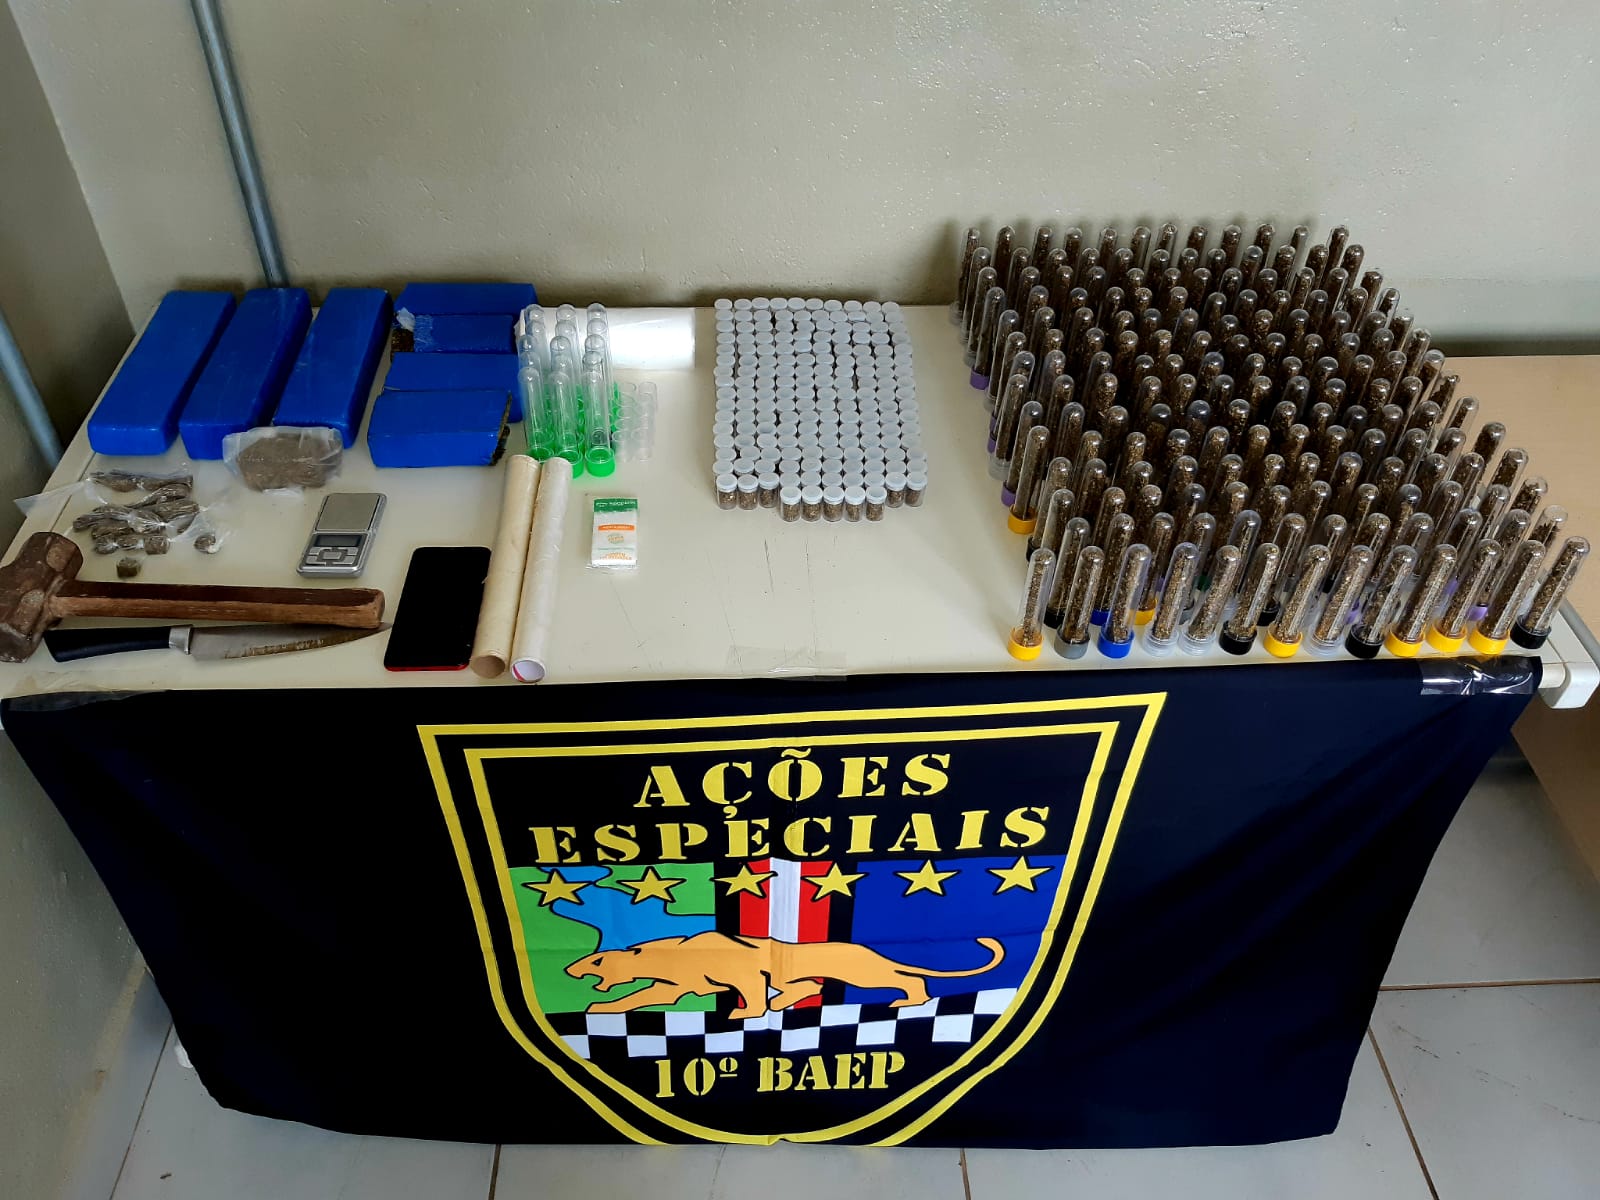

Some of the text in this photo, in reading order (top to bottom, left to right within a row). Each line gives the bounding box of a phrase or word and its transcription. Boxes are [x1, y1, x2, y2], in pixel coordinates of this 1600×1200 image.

[634, 747, 951, 820] AÇÕES
[529, 806, 1051, 863] ESPECIAIS
[655, 1052, 905, 1098] 10º BAEP
